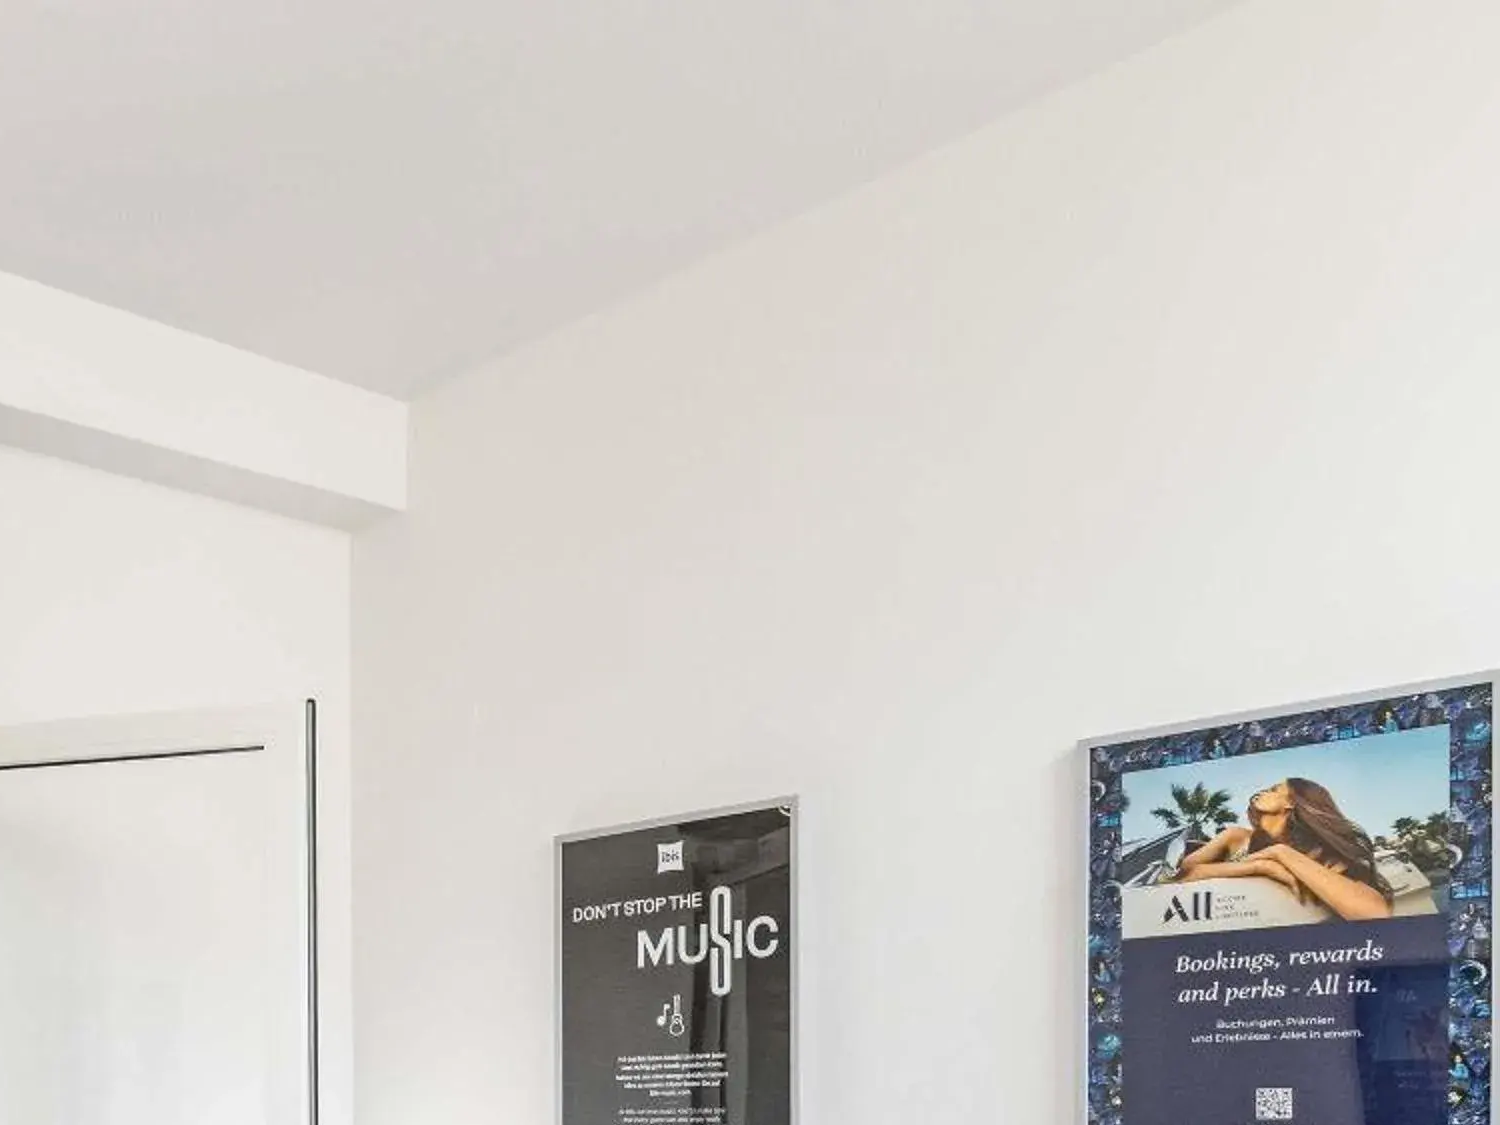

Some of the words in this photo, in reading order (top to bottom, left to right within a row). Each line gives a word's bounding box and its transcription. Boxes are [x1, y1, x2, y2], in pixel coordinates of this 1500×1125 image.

[572, 902, 621, 922] DON'T
[623, 897, 667, 917] STOP
[668, 891, 703, 911] THE
[1163, 891, 1212, 923] All
[637, 885, 779, 996] MUSIC
[1175, 950, 1281, 974] Bookings,
[1288, 939, 1384, 966] rewards
[1177, 982, 1219, 1003] and
[1224, 977, 1286, 1006] perks
[1306, 974, 1340, 997] All
[1347, 975, 1378, 994] in.
[1191, 1033, 1213, 1043] und
